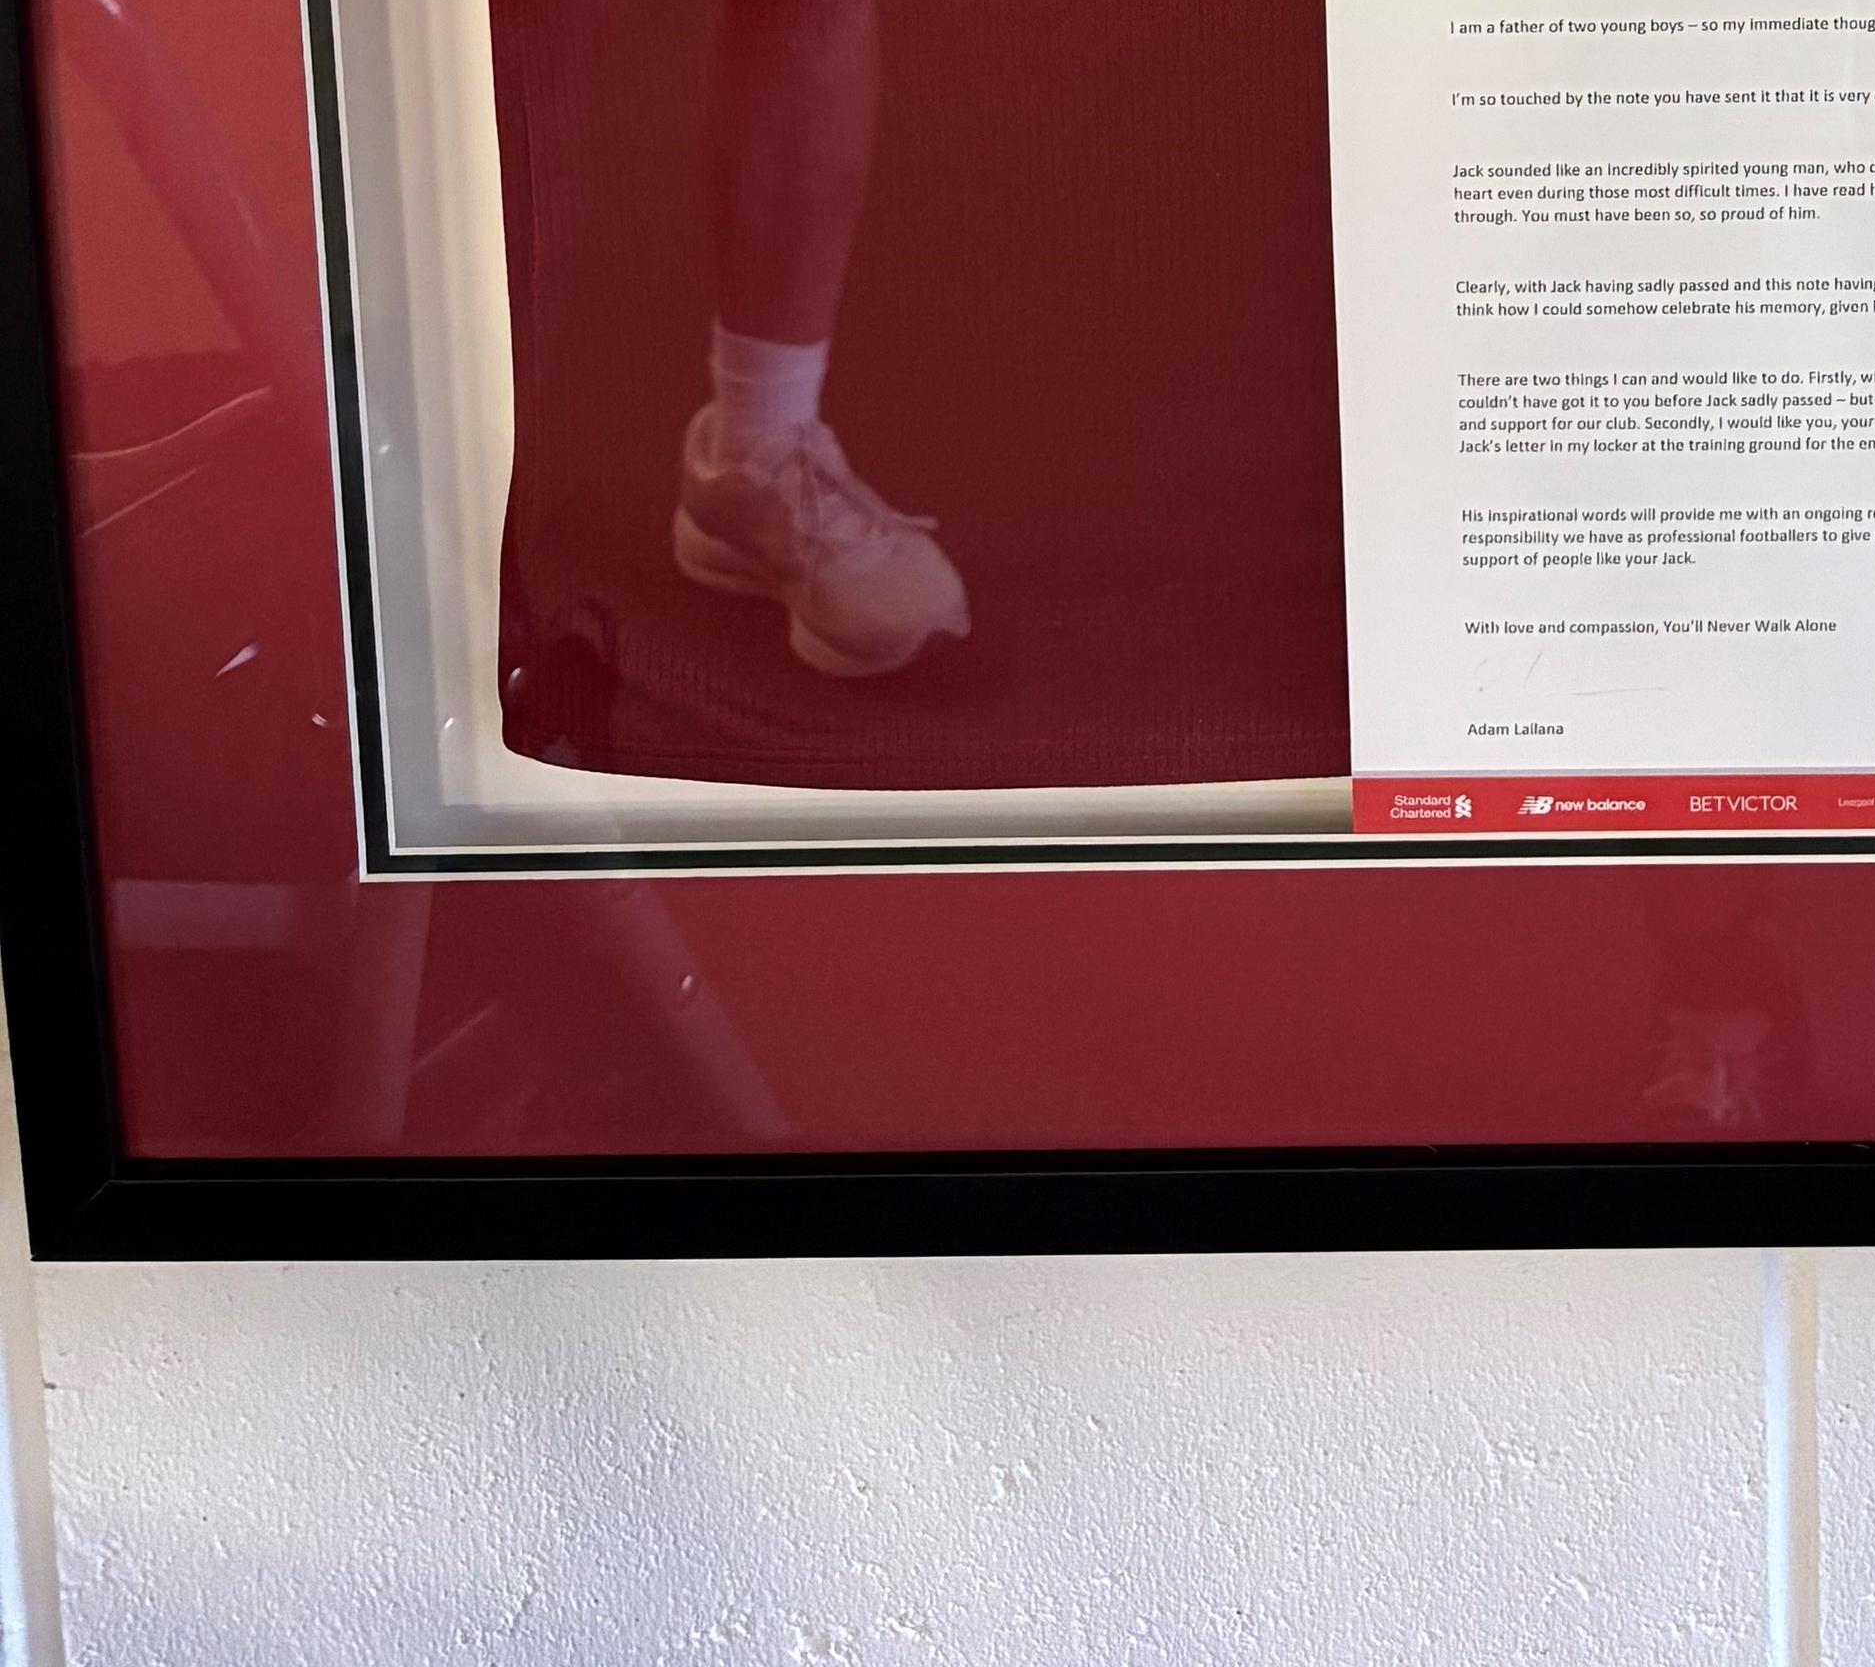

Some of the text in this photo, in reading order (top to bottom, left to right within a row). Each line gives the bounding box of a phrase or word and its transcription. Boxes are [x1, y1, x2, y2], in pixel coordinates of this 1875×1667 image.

[1454, 206, 1820, 226] through. You must have been so, so proud of him.
[1456, 303, 1494, 316] think
[1498, 303, 1530, 316] how
[1534, 303, 1538, 316] I
[1542, 302, 1584, 315] could
[1586, 301, 1658, 315] somehow
[1662, 301, 1731, 315] celebrate
[1736, 300, 1756, 314] his
[1760, 303, 1826, 317] memory,
[1830, 300, 1868, 315] given
[1506, 439, 1546, 453] letter
[1550, 439, 1563, 453] in
[1568, 442, 1590, 456] my
[1594, 438, 1638, 452] locker
[1642, 440, 1656, 452] at
[1660, 438, 1687, 451] the
[1689, 438, 1746, 454] training
[1749, 437, 1801, 453] ground
[1806, 437, 1827, 451] for
[1830, 436, 1855, 450] the
[1462, 531, 1560, 547] responsibility
[1563, 534, 1585, 544] we
[1589, 530, 1624, 544] have
[1628, 533, 1643, 543] as
[1648, 529, 1736, 546] professional
[1740, 528, 1818, 542] footballers
[1822, 530, 1838, 542] to
[1842, 529, 1871, 544] give
[1462, 551, 1696, 568] support of people like your Jack.
[1465, 621, 1500, 634] With
[1504, 621, 1534, 634] love
[1538, 620, 1565, 634] and
[1569, 621, 1659, 636] compassion,
[1708, 620, 1751, 633] Never
[1755, 619, 1791, 633] Walk
[1795, 619, 1837, 632] Alone
[1468, 723, 1564, 735] Adam Lallana
[1394, 794, 1451, 806] Standard
[1555, 800, 1584, 811] new
[1587, 798, 1646, 811] balance
[1690, 795, 1798, 812] BETVICTOR
[1390, 807, 1451, 819] Chartered
